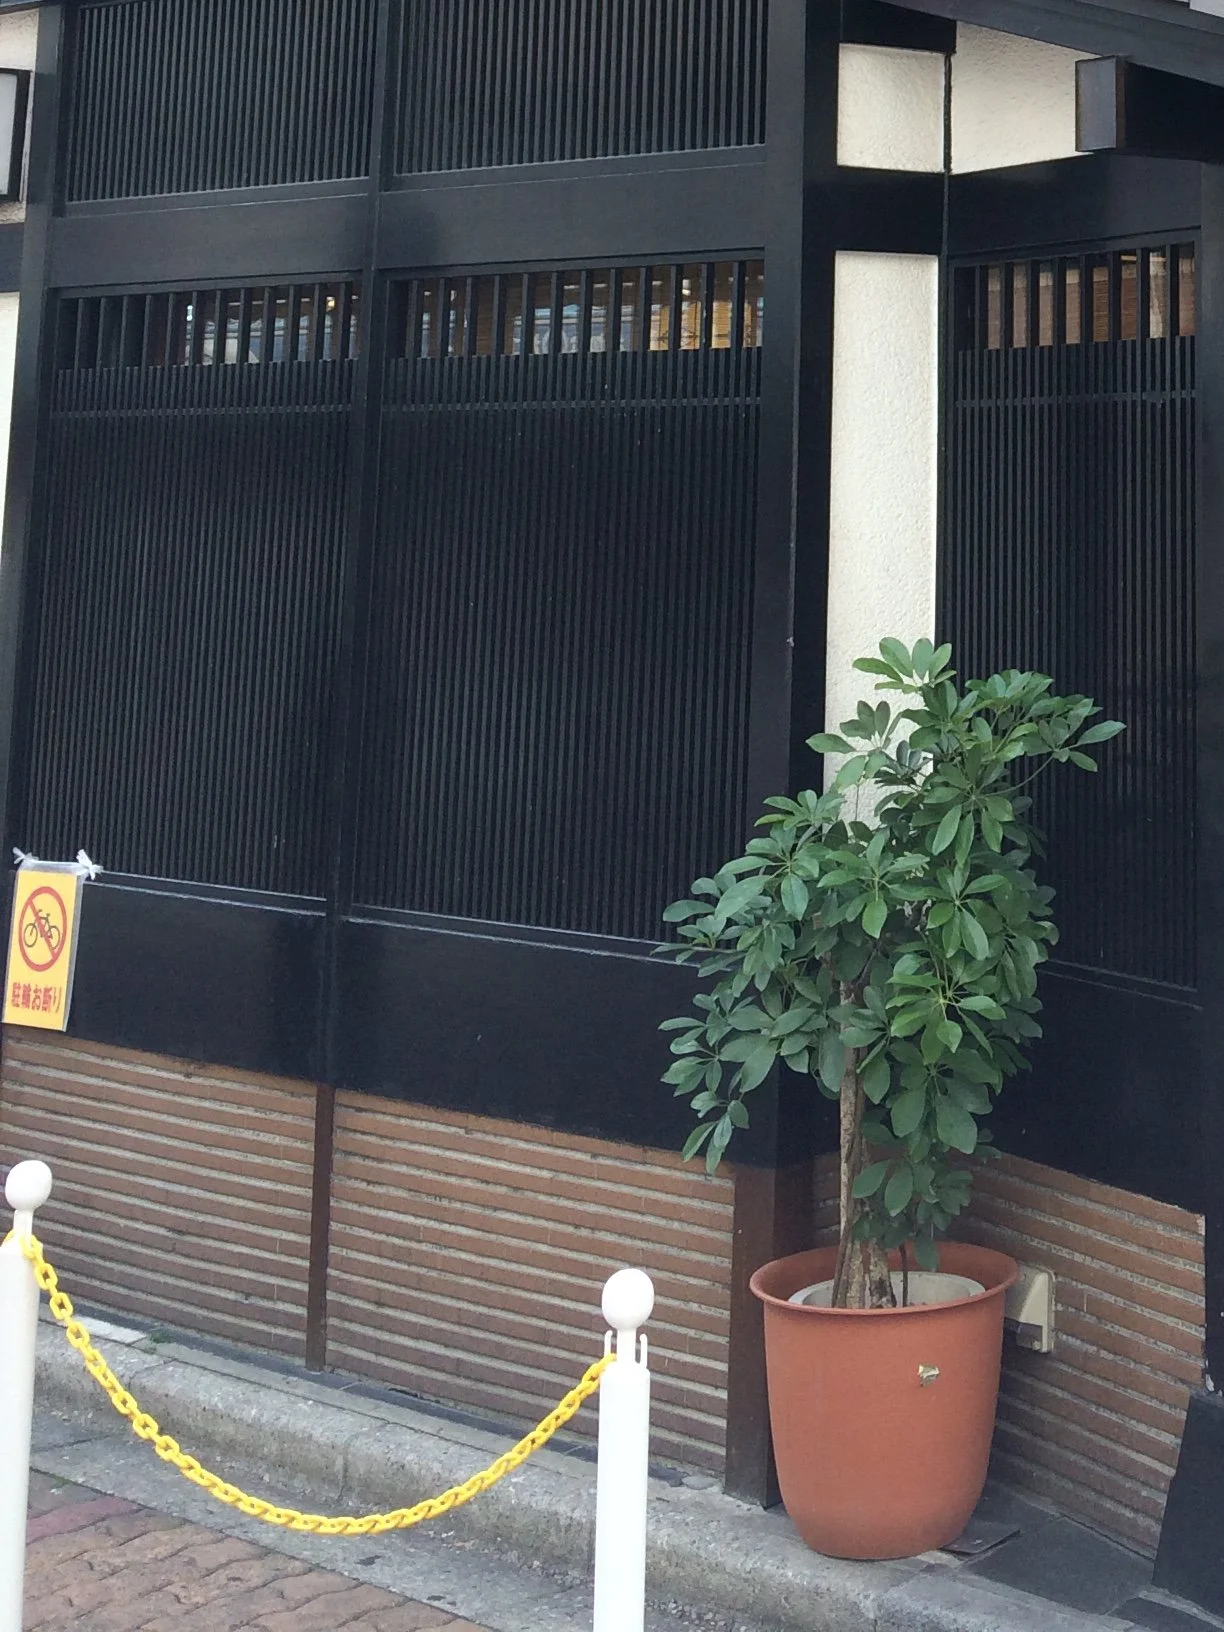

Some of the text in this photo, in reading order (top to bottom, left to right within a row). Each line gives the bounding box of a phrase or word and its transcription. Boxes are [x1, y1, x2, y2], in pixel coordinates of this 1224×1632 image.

[11, 981, 63, 1014] 駐輪お断り
